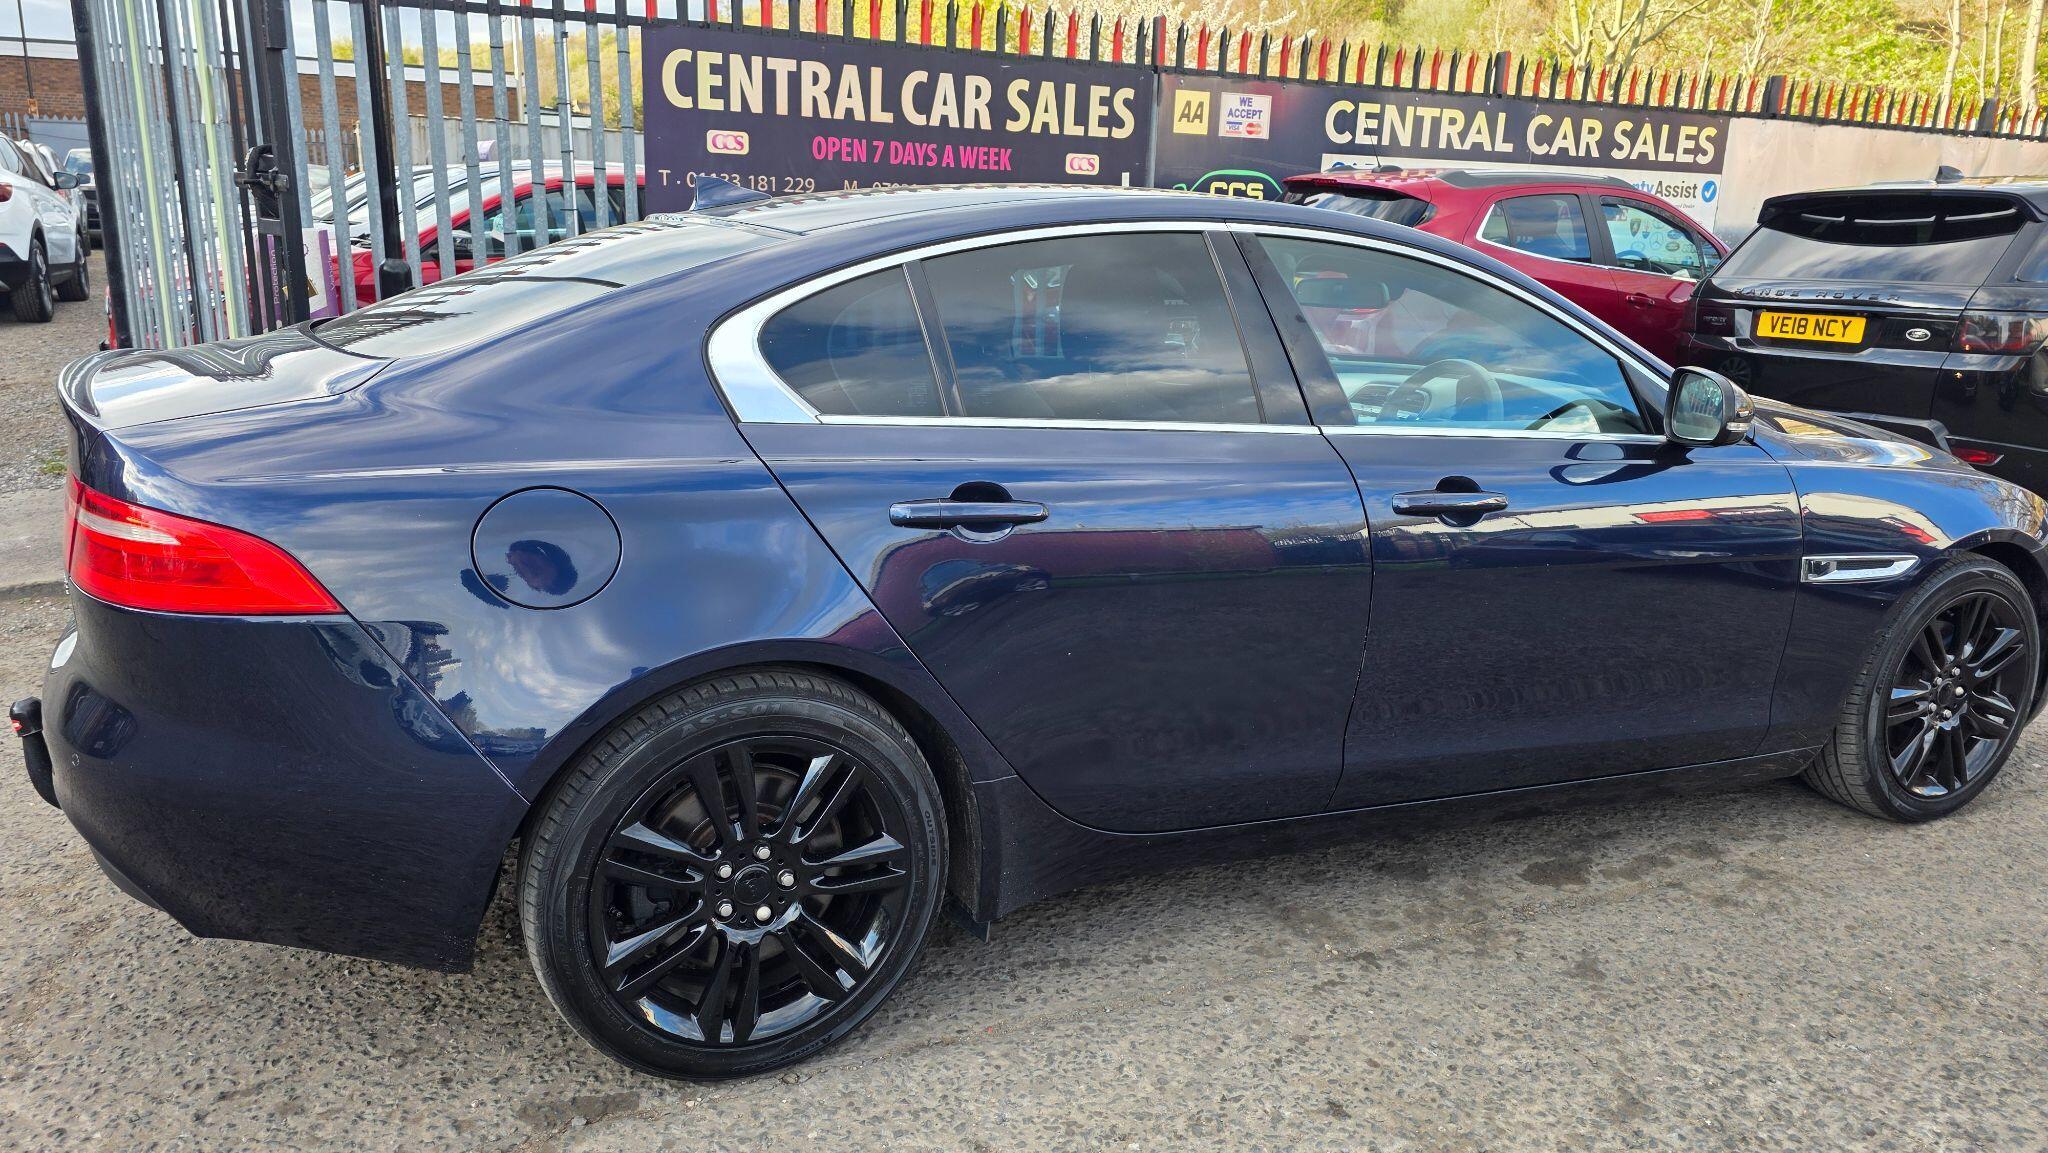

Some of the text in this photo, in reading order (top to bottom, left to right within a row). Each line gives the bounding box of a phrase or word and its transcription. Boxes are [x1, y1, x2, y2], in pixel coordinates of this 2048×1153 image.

[662, 48, 1135, 139] CENTRAL CAR SALES
[1239, 96, 1253, 107] WE
[1178, 100, 1205, 124] AA
[1227, 107, 1263, 120] ACCEPT
[1325, 100, 1718, 165] CENTRAL CAR SALES
[812, 135, 1012, 171] OPEN 7 DAYS A WEEK
[748, 175, 776, 191] 181
[783, 177, 815, 193] 229
[269, 249, 280, 304] Protection
[1734, 287, 1901, 301] RANGE ROVER
[1770, 315, 1853, 338] VE18 NCY
